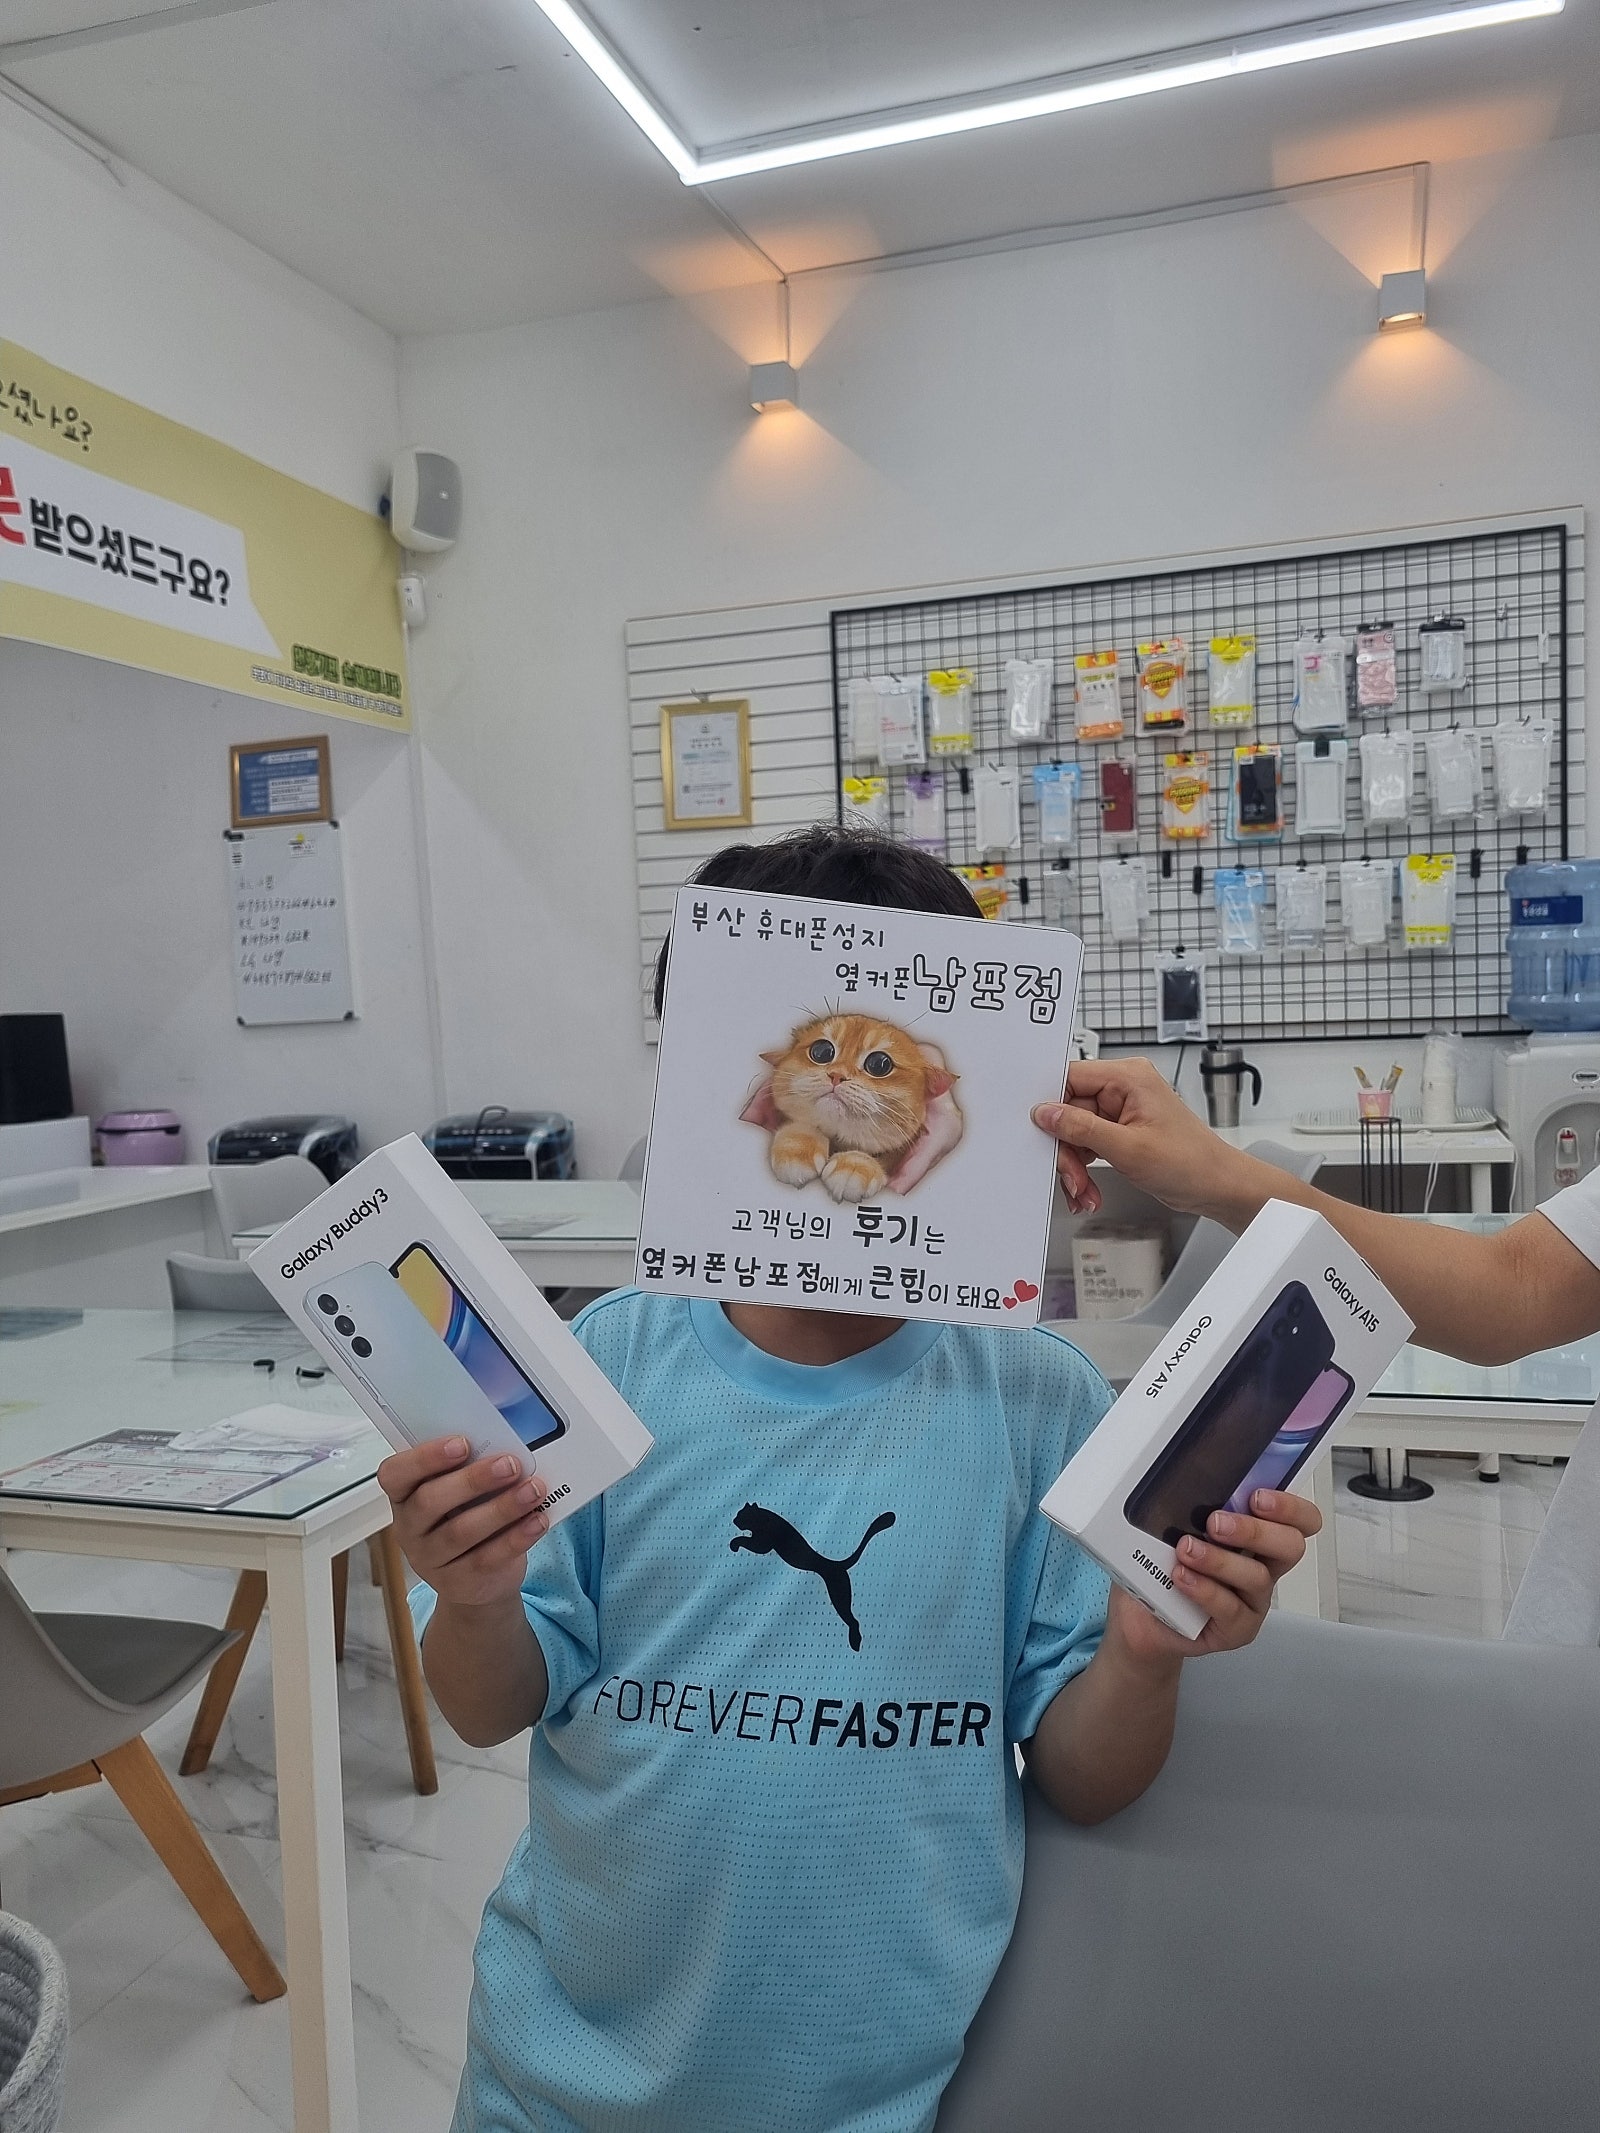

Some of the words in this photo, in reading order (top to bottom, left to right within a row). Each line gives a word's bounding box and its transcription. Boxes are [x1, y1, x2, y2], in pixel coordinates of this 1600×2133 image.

[30, 497, 230, 606] 받으셨드구요?
[691, 902, 745, 938] 부산
[757, 908, 884, 951] 휴대폰성지
[280, 1232, 334, 1280] Galaxy
[329, 1188, 389, 1241] Buddy3
[731, 1208, 832, 1239] 고객님의
[852, 1205, 946, 1254] 후기는
[955, 1284, 1001, 1309] 돼요
[1323, 1266, 1366, 1316] Galaxy
[1358, 1308, 1380, 1333] A15
[1162, 1315, 1212, 1373] Galaxy
[1145, 1370, 1169, 1399] A15
[1132, 1549, 1175, 1591] SAMSUNG
[593, 1675, 803, 1745] FOREVER
[809, 1699, 992, 1749] FASTER
